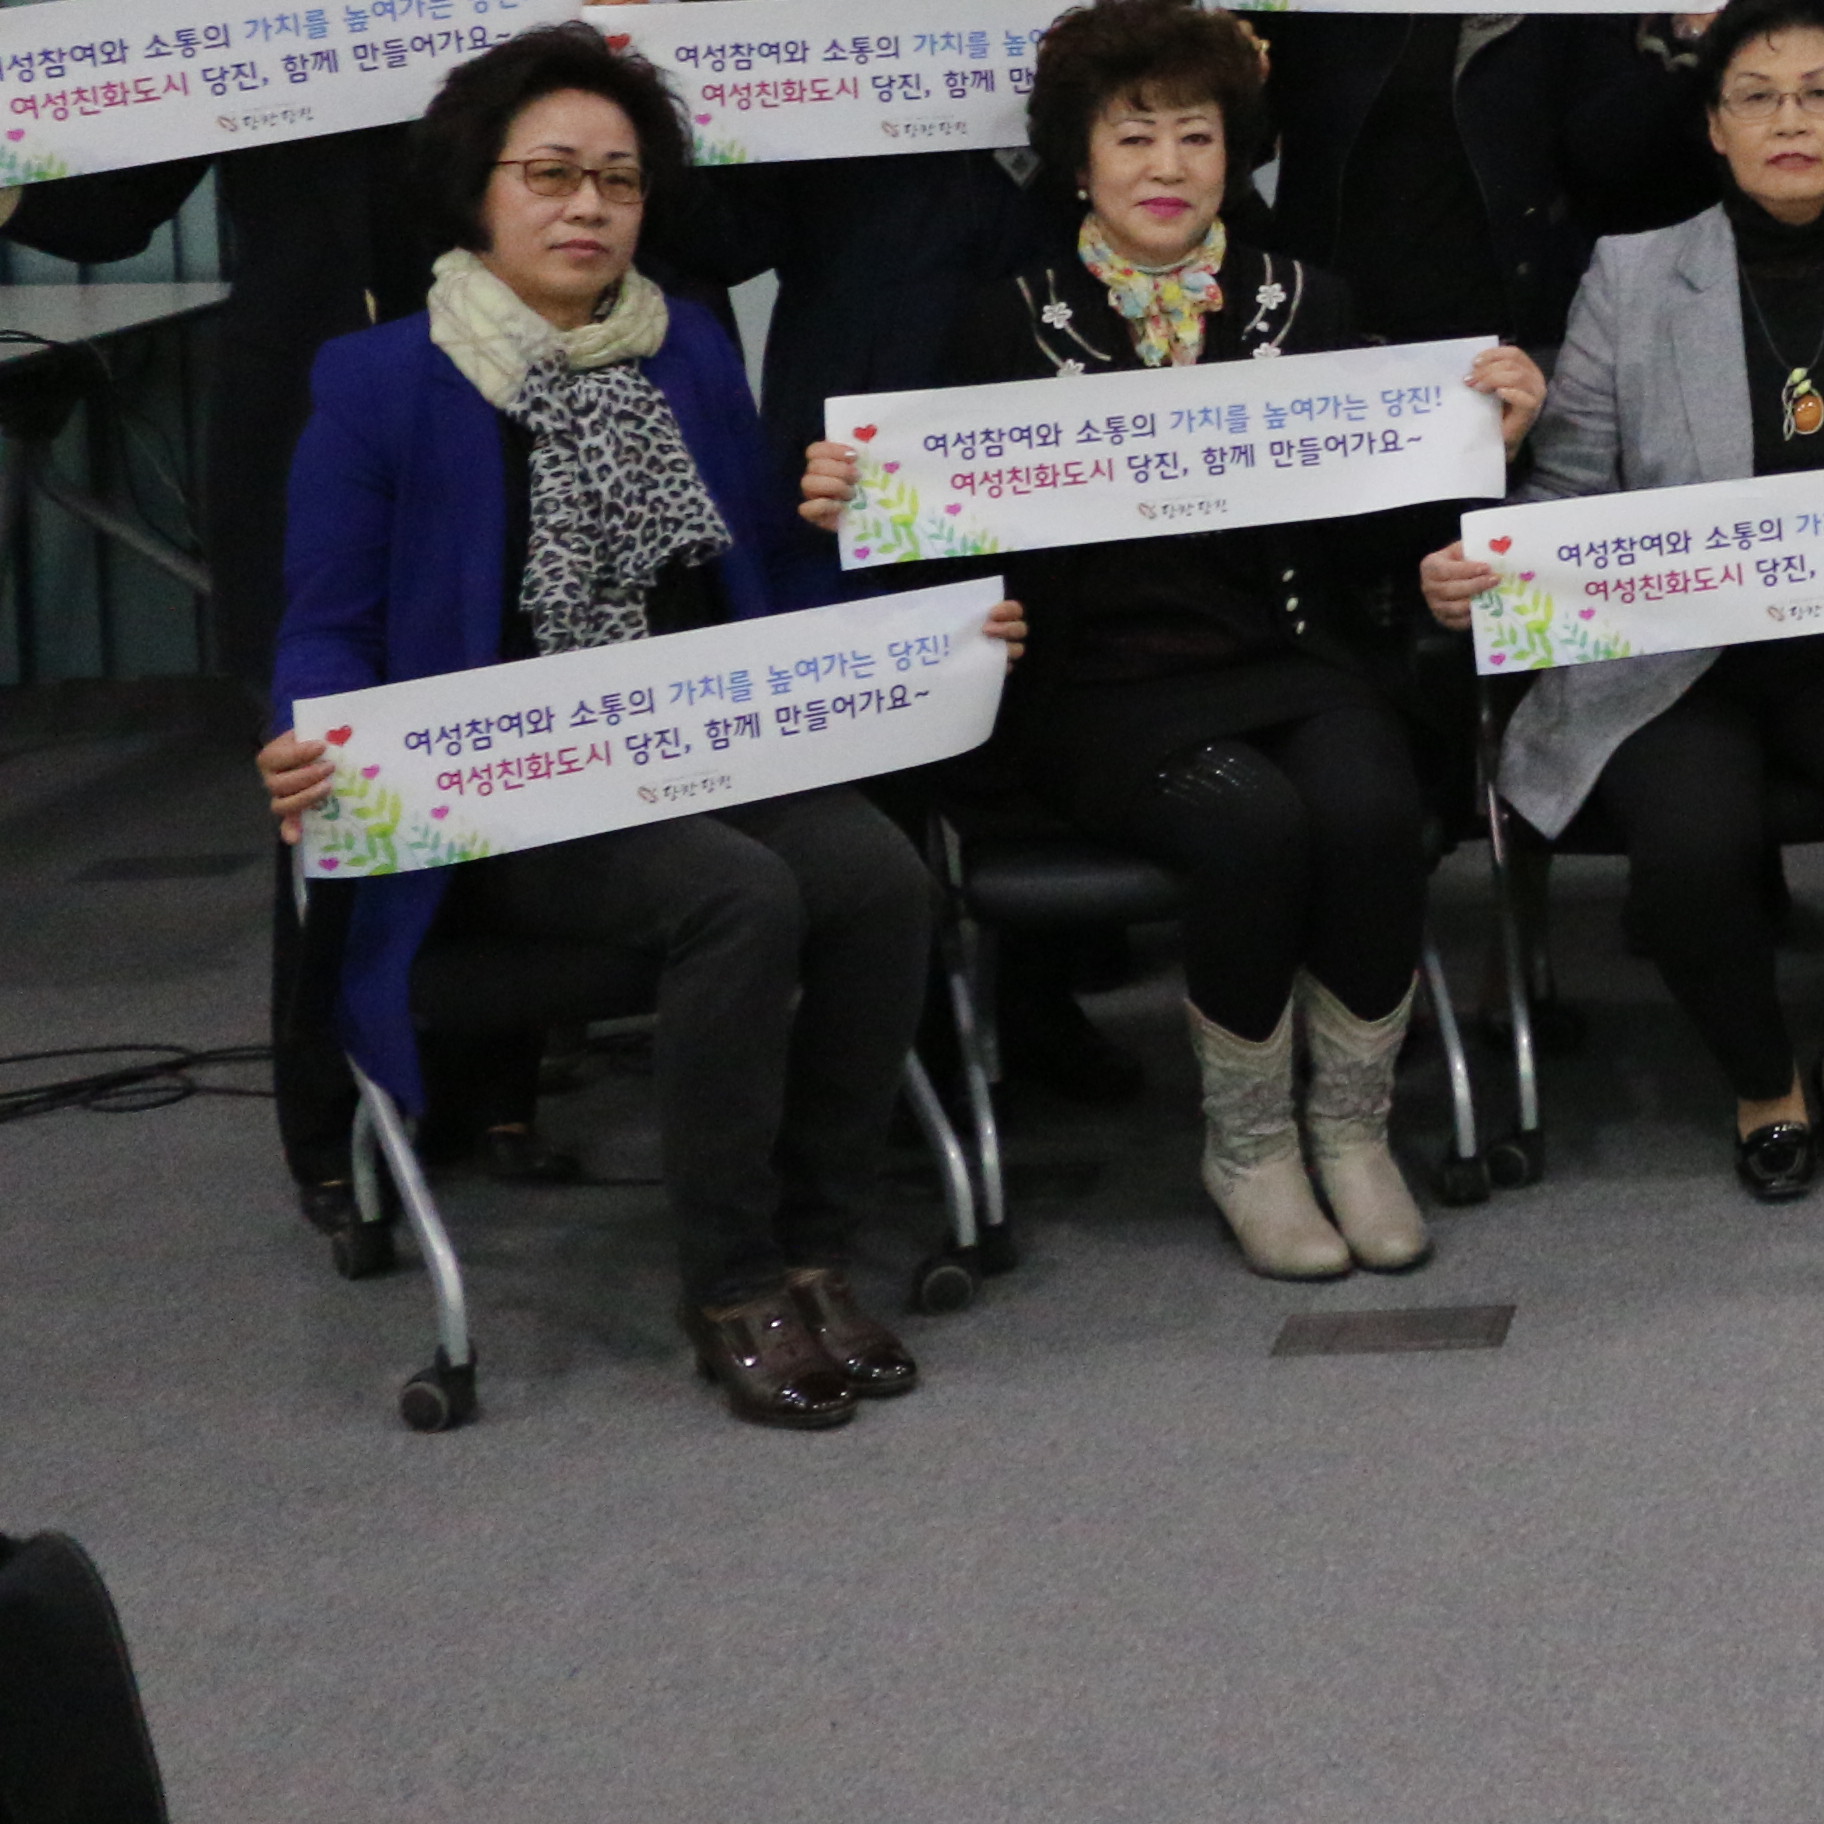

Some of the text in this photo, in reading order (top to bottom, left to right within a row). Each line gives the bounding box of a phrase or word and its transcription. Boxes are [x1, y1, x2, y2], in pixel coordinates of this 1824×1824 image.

[9, 71, 190, 122] 여성친화도시
[200, 60, 270, 97] 당진,
[280, 48, 340, 85] 함께
[922, 385, 1442, 462] 여성참여와 소통의 가치를 높여가는 당진!
[949, 428, 1423, 500] 여성친화도시 당진, 함께 만들어가요~
[1556, 528, 1693, 570] 여성참여와
[1705, 516, 1784, 552] 소통의
[1582, 562, 1744, 605] 여성친화도시
[1754, 553, 1817, 588] 당진,
[403, 634, 950, 757] 여성참여와 소통의 가치를 높여가는 당진!
[435, 683, 930, 798] 여성친화도시 당진, 함께 만들어가요~
